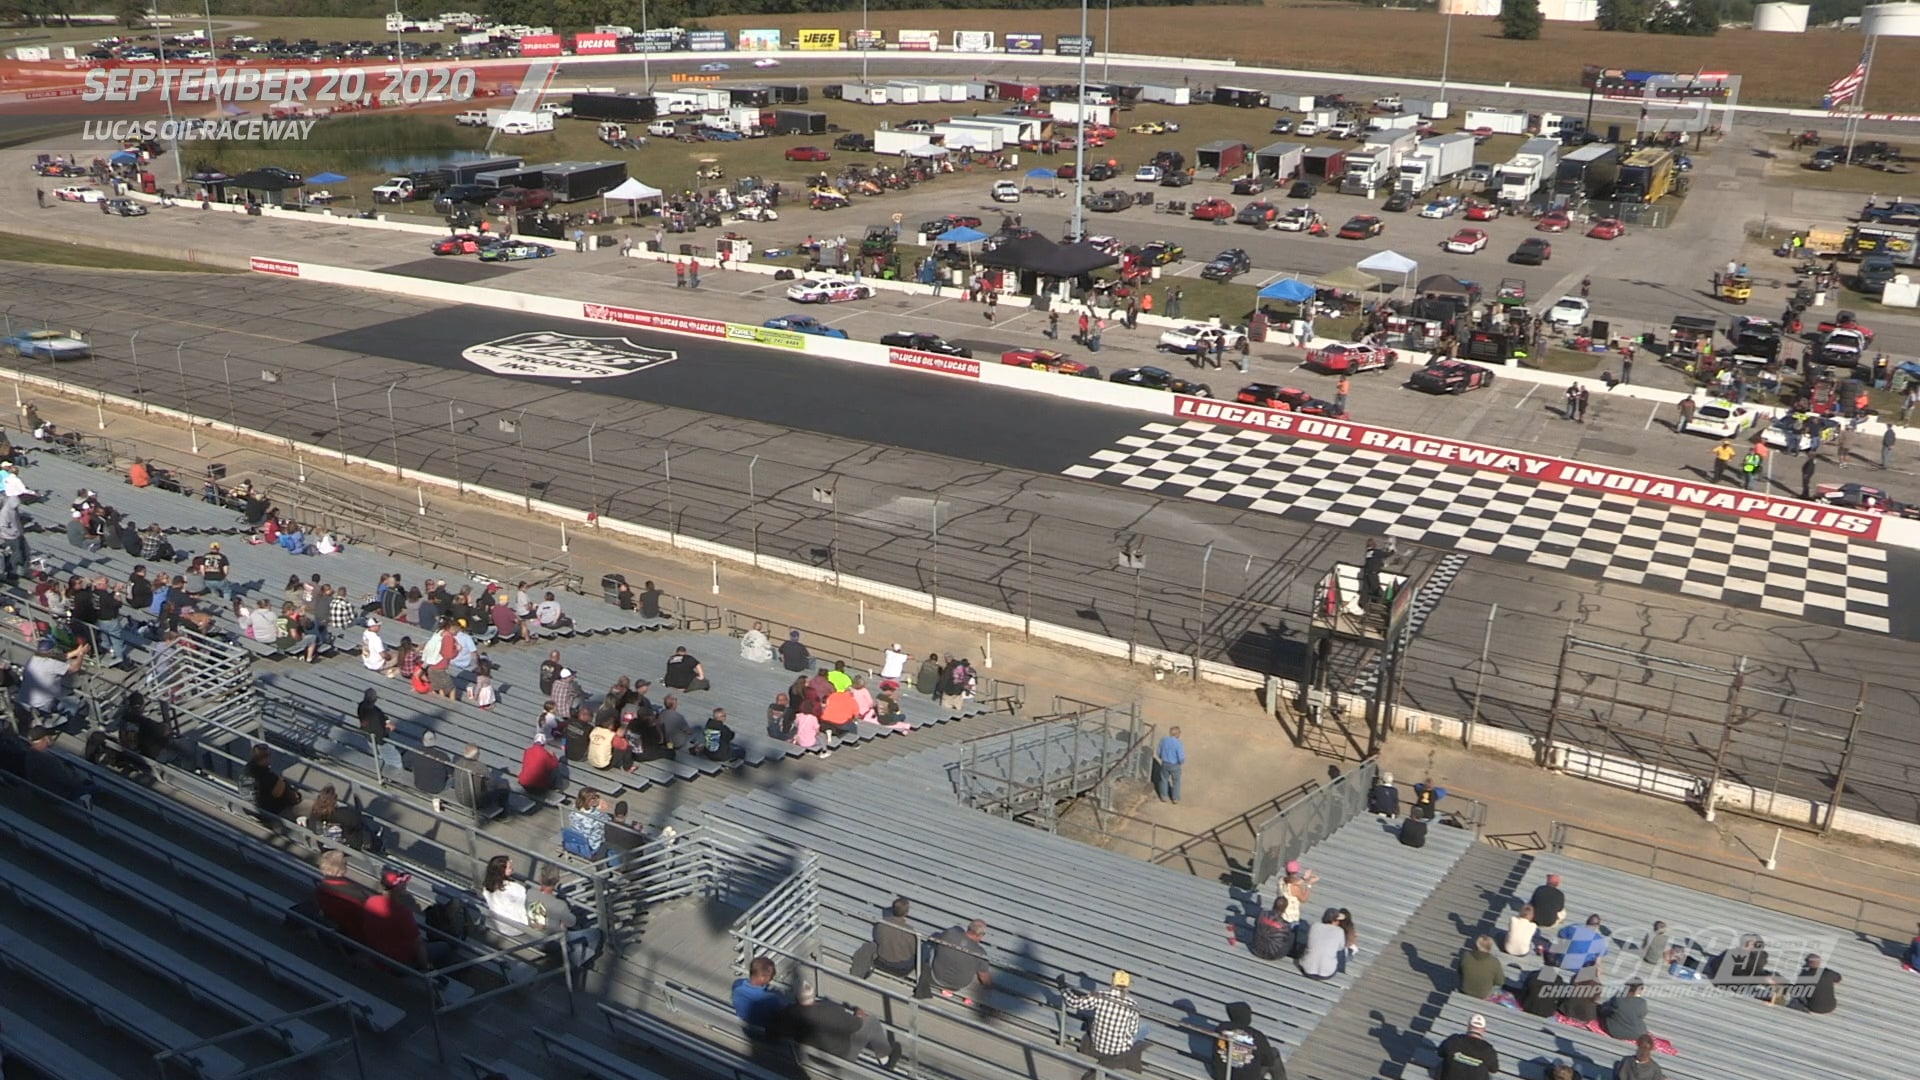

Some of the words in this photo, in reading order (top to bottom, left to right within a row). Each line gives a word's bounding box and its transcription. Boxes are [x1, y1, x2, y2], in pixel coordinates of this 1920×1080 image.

[578, 40, 603, 49] LUCAS
[604, 40, 616, 49] OIL
[805, 33, 836, 43] JEGS
[660, 317, 680, 327] LUCAS
[680, 319, 689, 329] OIL
[697, 321, 715, 333] LUCAS
[716, 324, 726, 334] OIL
[471, 349, 500, 358] OIL
[506, 353, 614, 376] PRODUCTS
[899, 353, 921, 364] LUCAS
[922, 356, 934, 366] OIL
[943, 361, 967, 372] LUCAS
[967, 365, 980, 374] OIL
[1179, 400, 1292, 430] LUCAS
[1298, 418, 1352, 442] OIL
[1360, 430, 1551, 475] RACEWAY
[1559, 466, 1875, 534] INDIANAPOLIS
